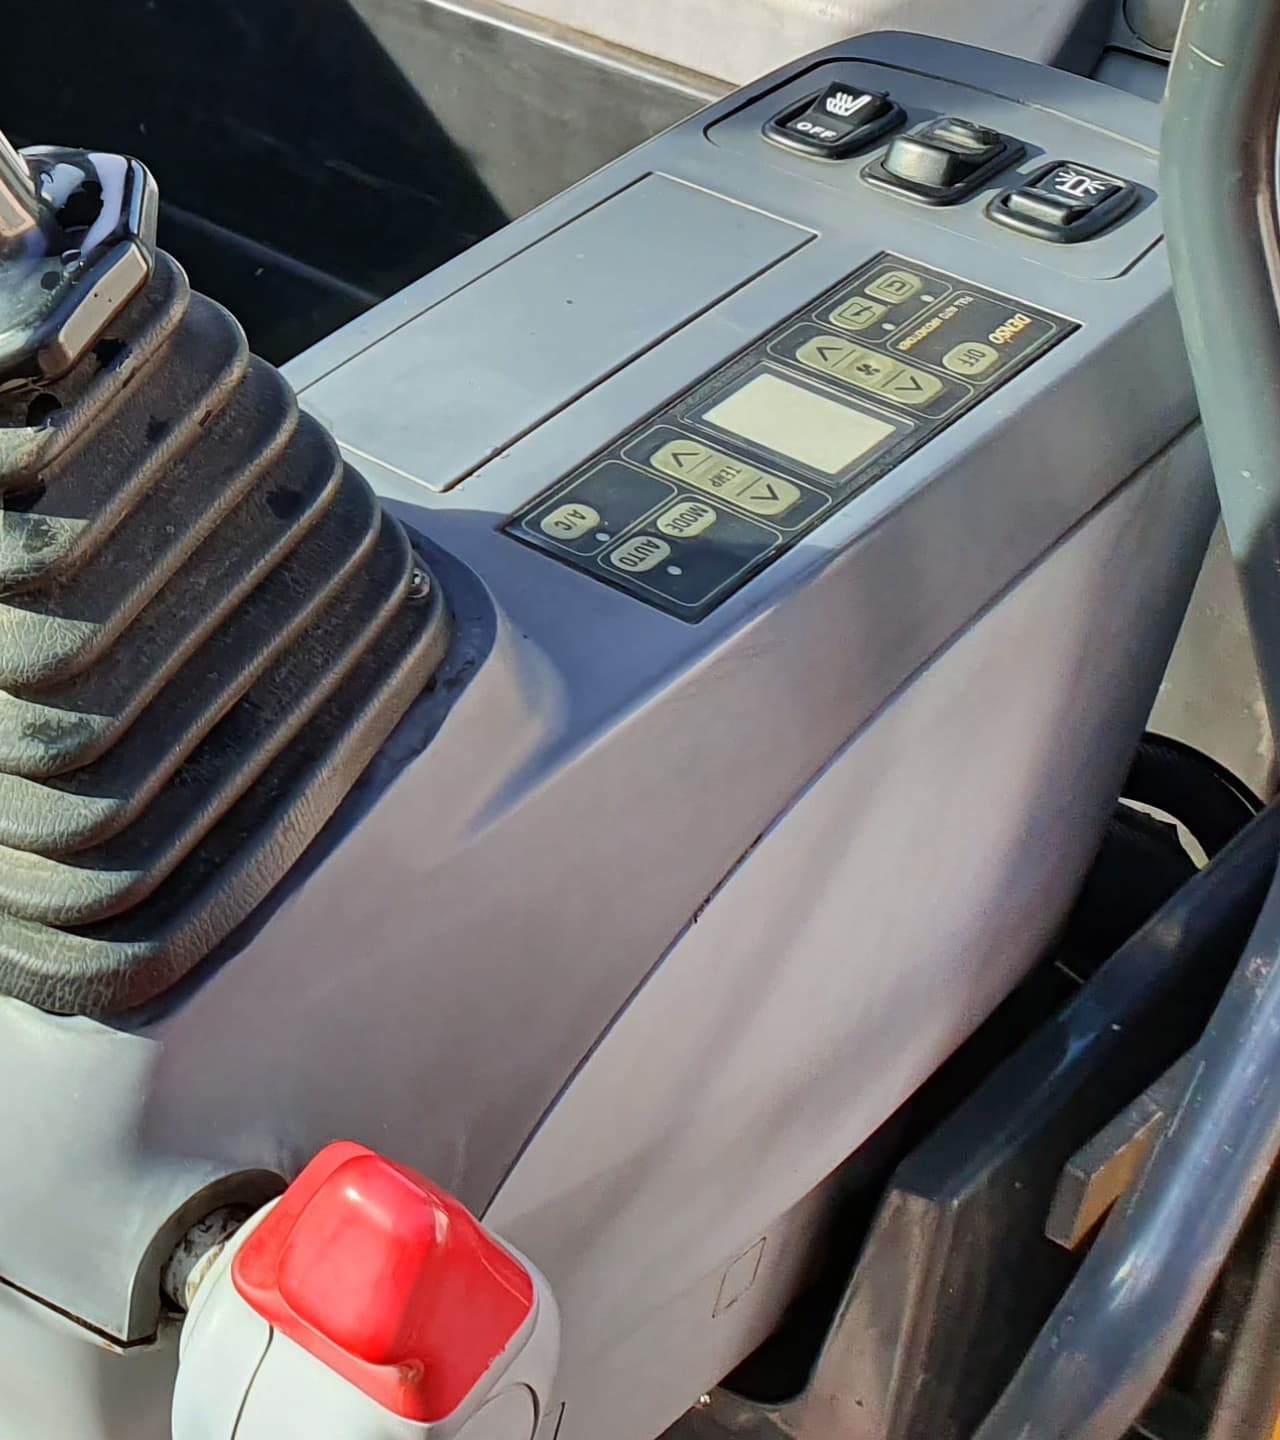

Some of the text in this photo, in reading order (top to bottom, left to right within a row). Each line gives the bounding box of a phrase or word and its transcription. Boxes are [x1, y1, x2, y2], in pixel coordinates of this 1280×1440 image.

[796, 121, 838, 138] OFF
[988, 313, 1032, 344] DENSO
[958, 348, 986, 368] OFF
[708, 465, 742, 488] TEMP
[554, 509, 586, 531] A/C
[664, 504, 709, 533] MODE
[618, 539, 662, 568] AUTO
